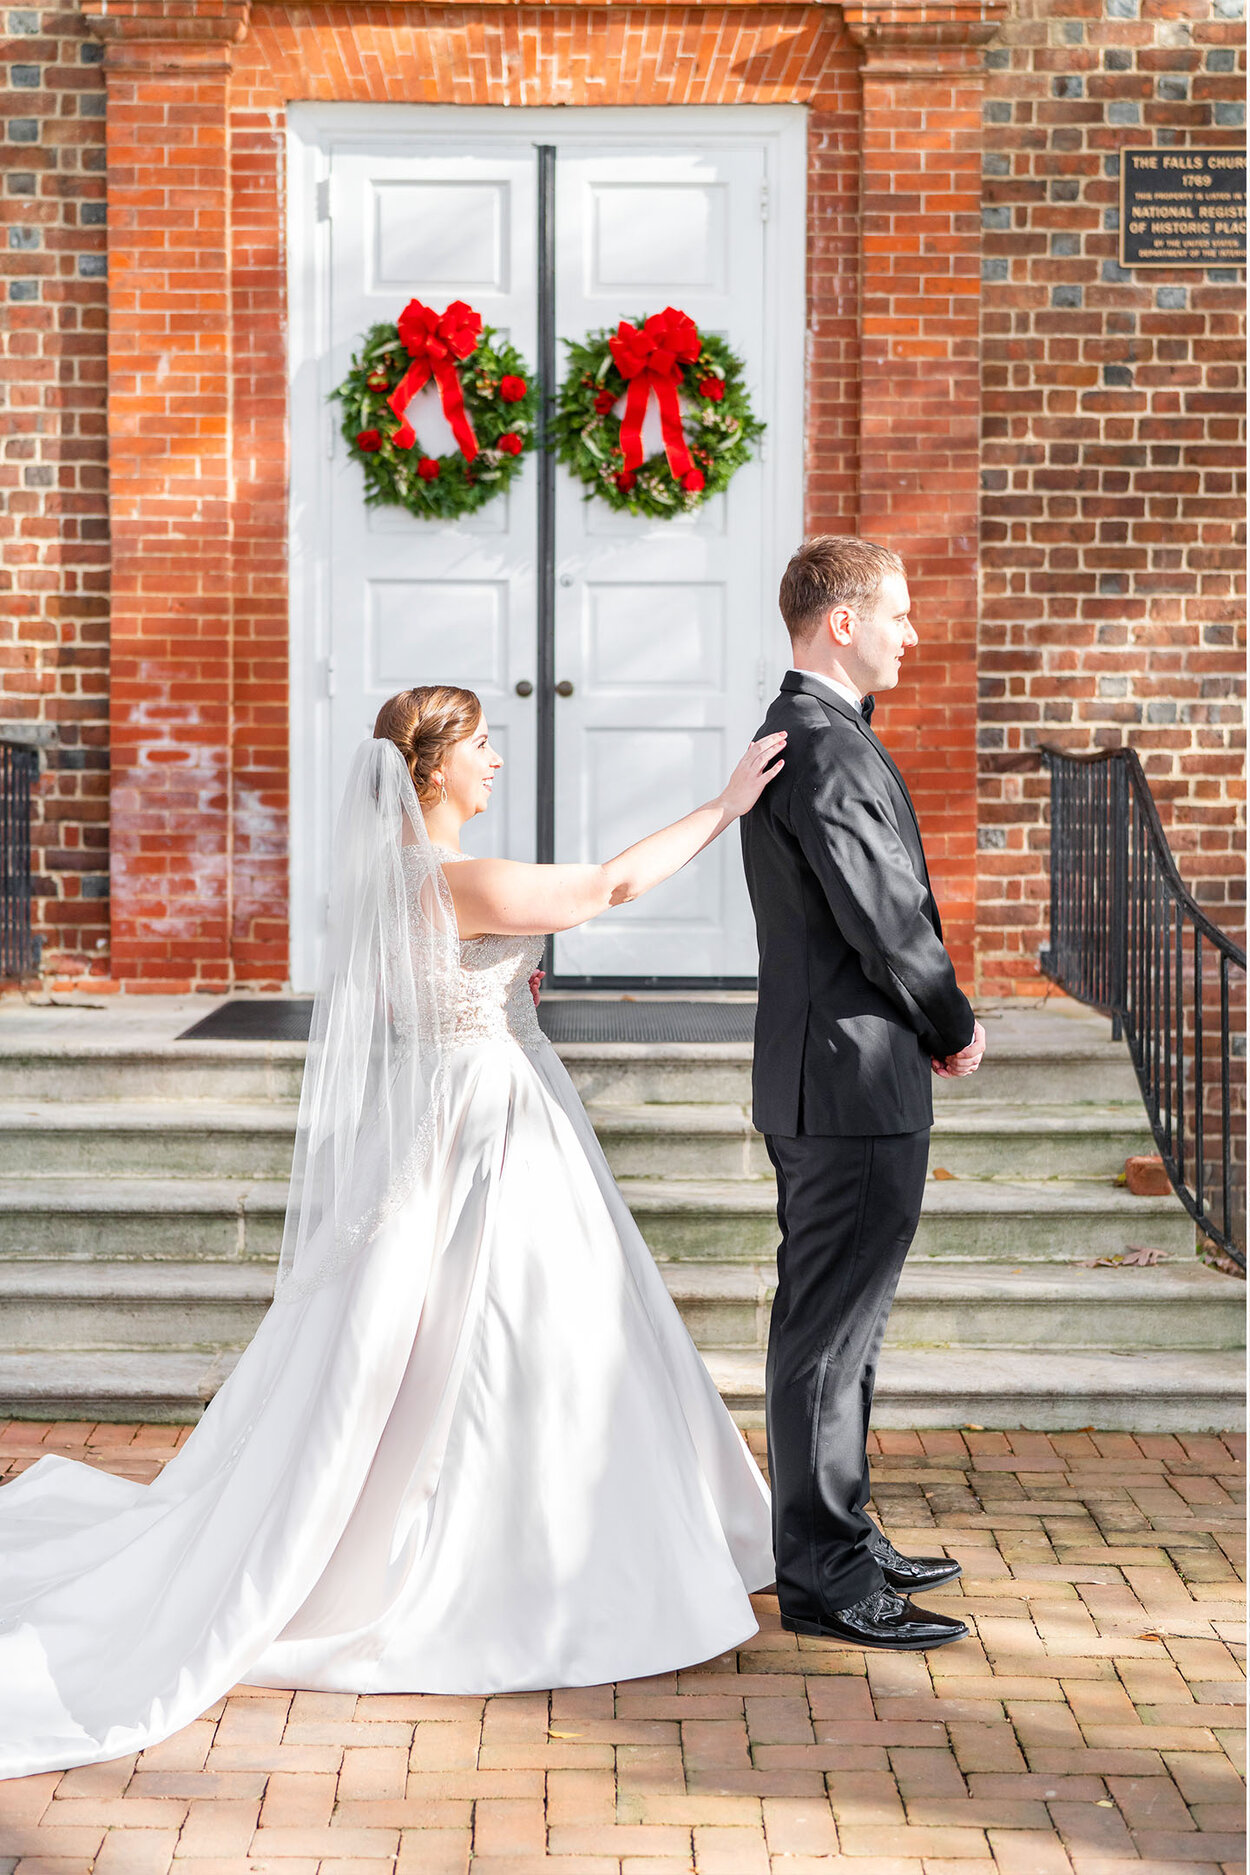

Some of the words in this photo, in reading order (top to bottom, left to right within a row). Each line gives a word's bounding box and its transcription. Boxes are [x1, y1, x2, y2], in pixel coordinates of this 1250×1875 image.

[1132, 156, 1158, 169] THE
[1162, 156, 1203, 169] FALLS
[1182, 174, 1212, 188] 1769
[1153, 191, 1193, 201] PROPERTY
[1131, 206, 1194, 219] NATIONAL
[1129, 221, 1147, 235] OF
[1151, 221, 1211, 235] HISTORIC
[1138, 249, 1188, 258] DEPARTMENT
